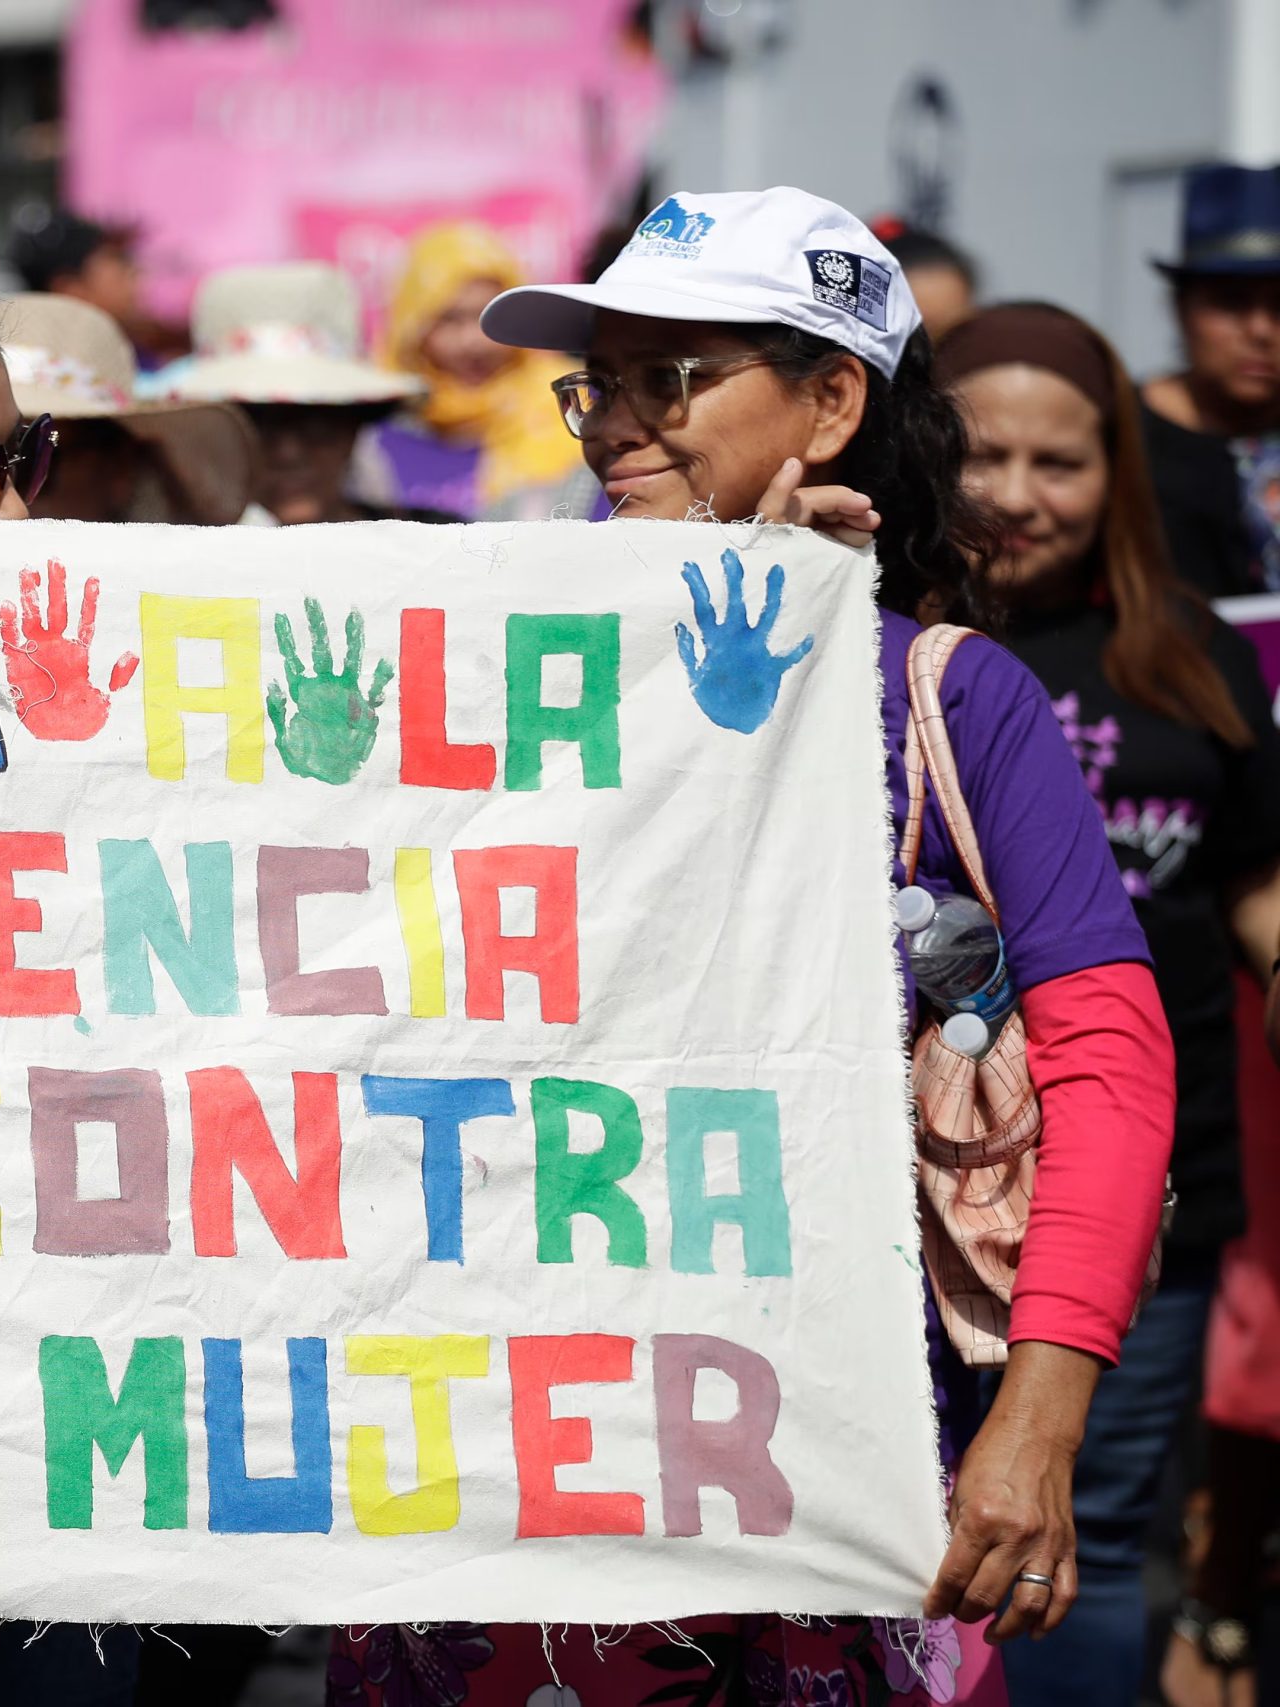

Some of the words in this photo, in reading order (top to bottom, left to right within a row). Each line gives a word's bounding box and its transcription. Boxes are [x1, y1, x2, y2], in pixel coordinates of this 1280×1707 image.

[140, 592, 265, 785] A
[399, 607, 622, 792] LA
[38, 1333, 795, 1541] MUJER
